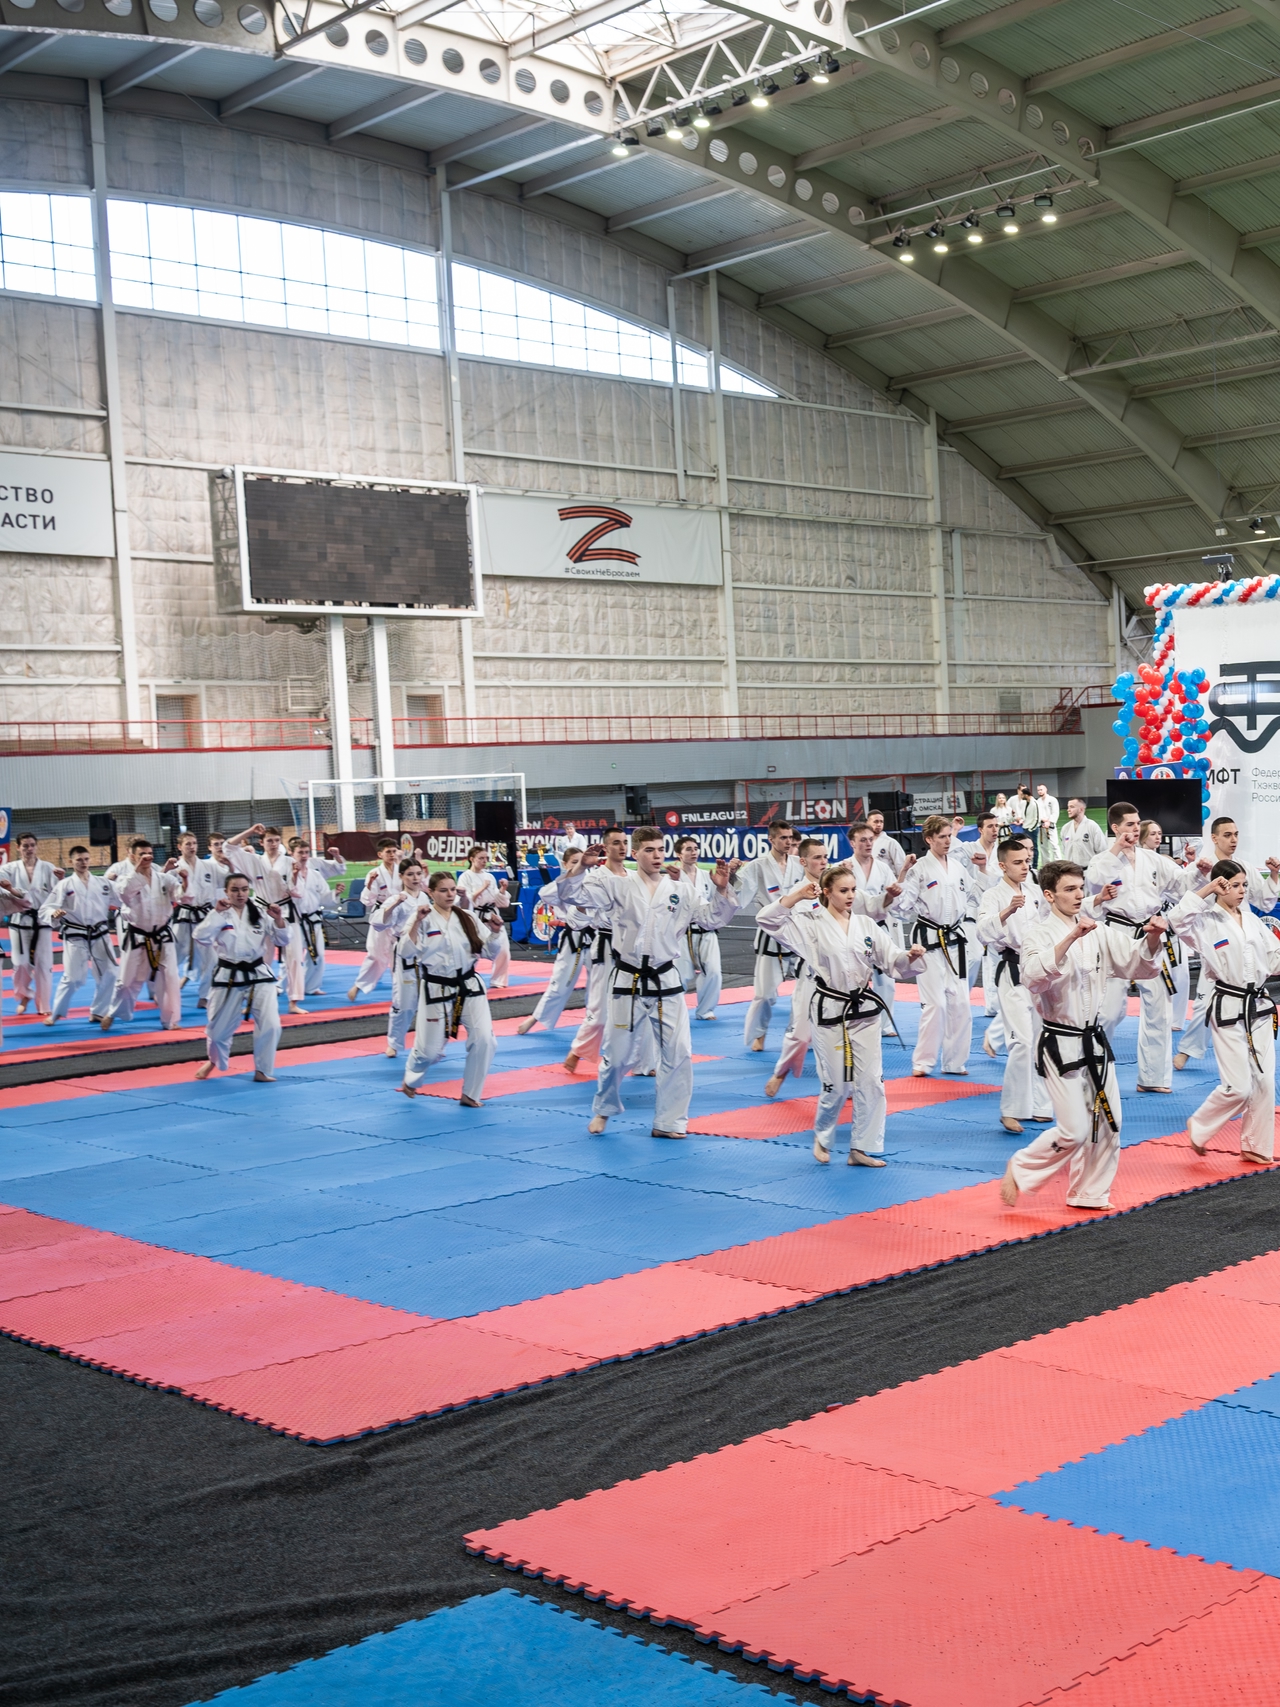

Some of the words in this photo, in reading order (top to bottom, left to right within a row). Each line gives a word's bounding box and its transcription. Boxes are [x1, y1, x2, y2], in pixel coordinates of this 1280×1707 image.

[1, 512, 56, 531] АСТИ
[564, 566, 640, 578] #СвоихНеБросаем
[681, 810, 749, 823] FNLEAGUE2
[785, 799, 847, 821] LEON
